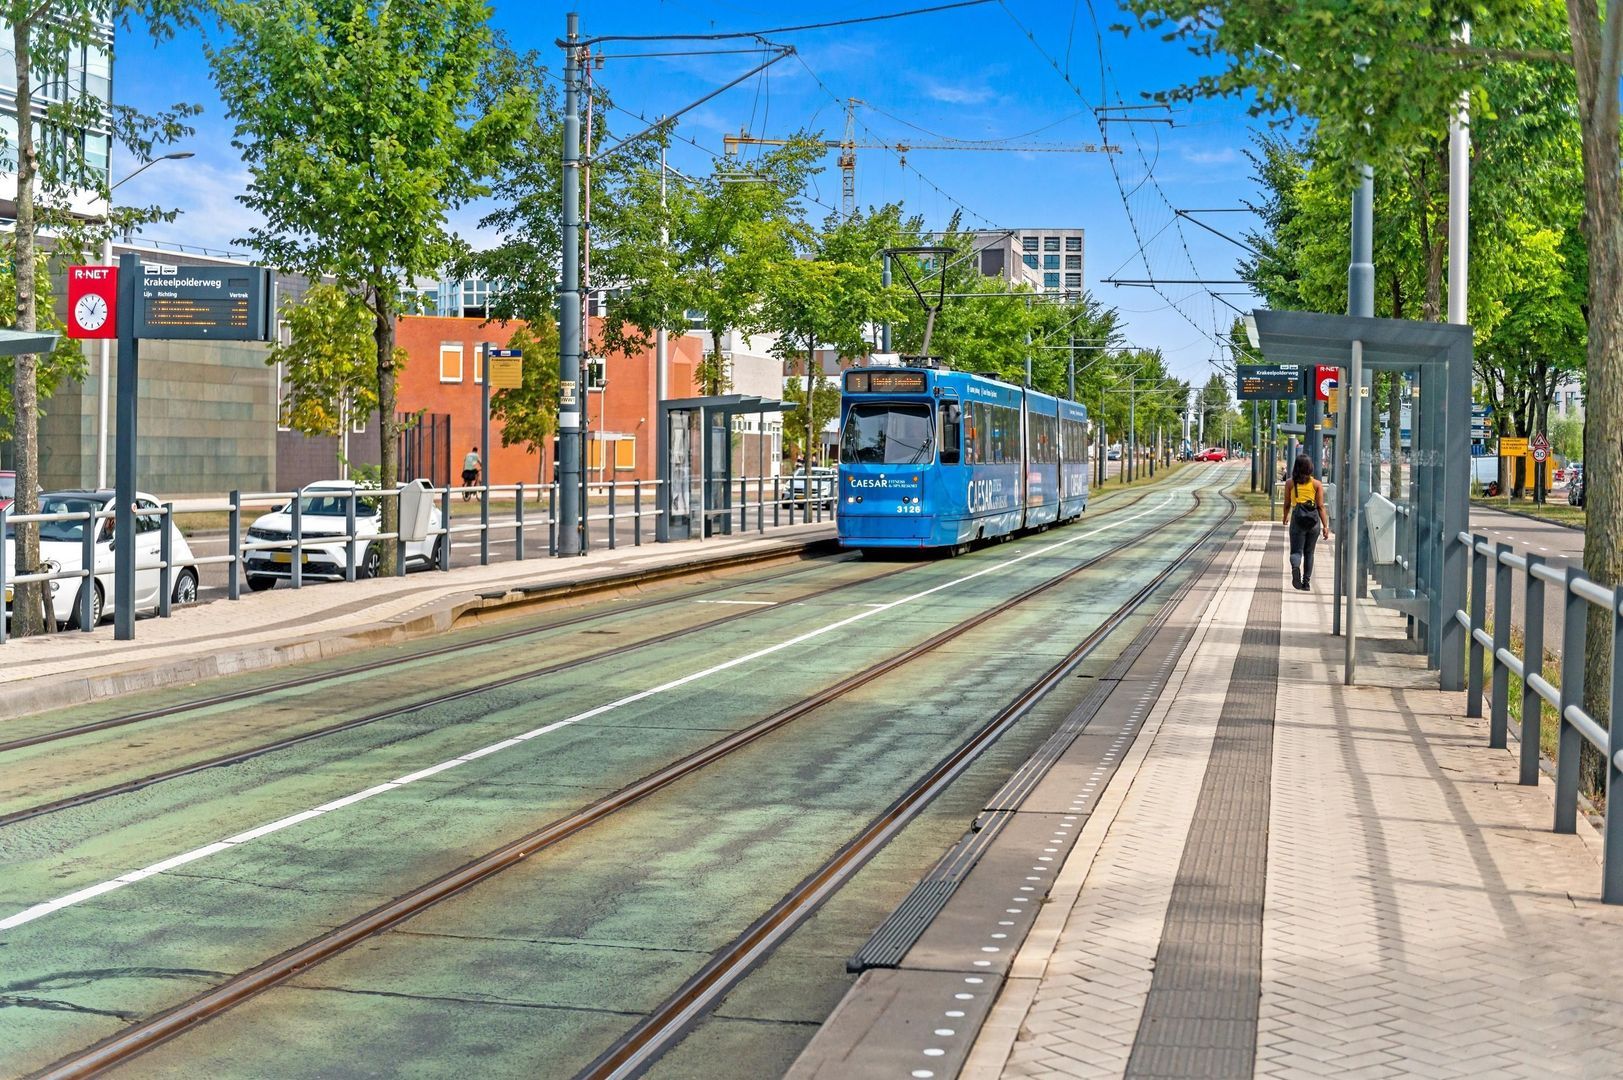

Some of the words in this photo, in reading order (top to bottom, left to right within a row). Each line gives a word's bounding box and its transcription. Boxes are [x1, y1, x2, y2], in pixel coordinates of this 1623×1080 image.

[143, 277, 222, 289] Krakeelpolderweg
[850, 479, 888, 488] CAESAR
[967, 479, 993, 514] CAESAR
[896, 505, 921, 514] 3126
